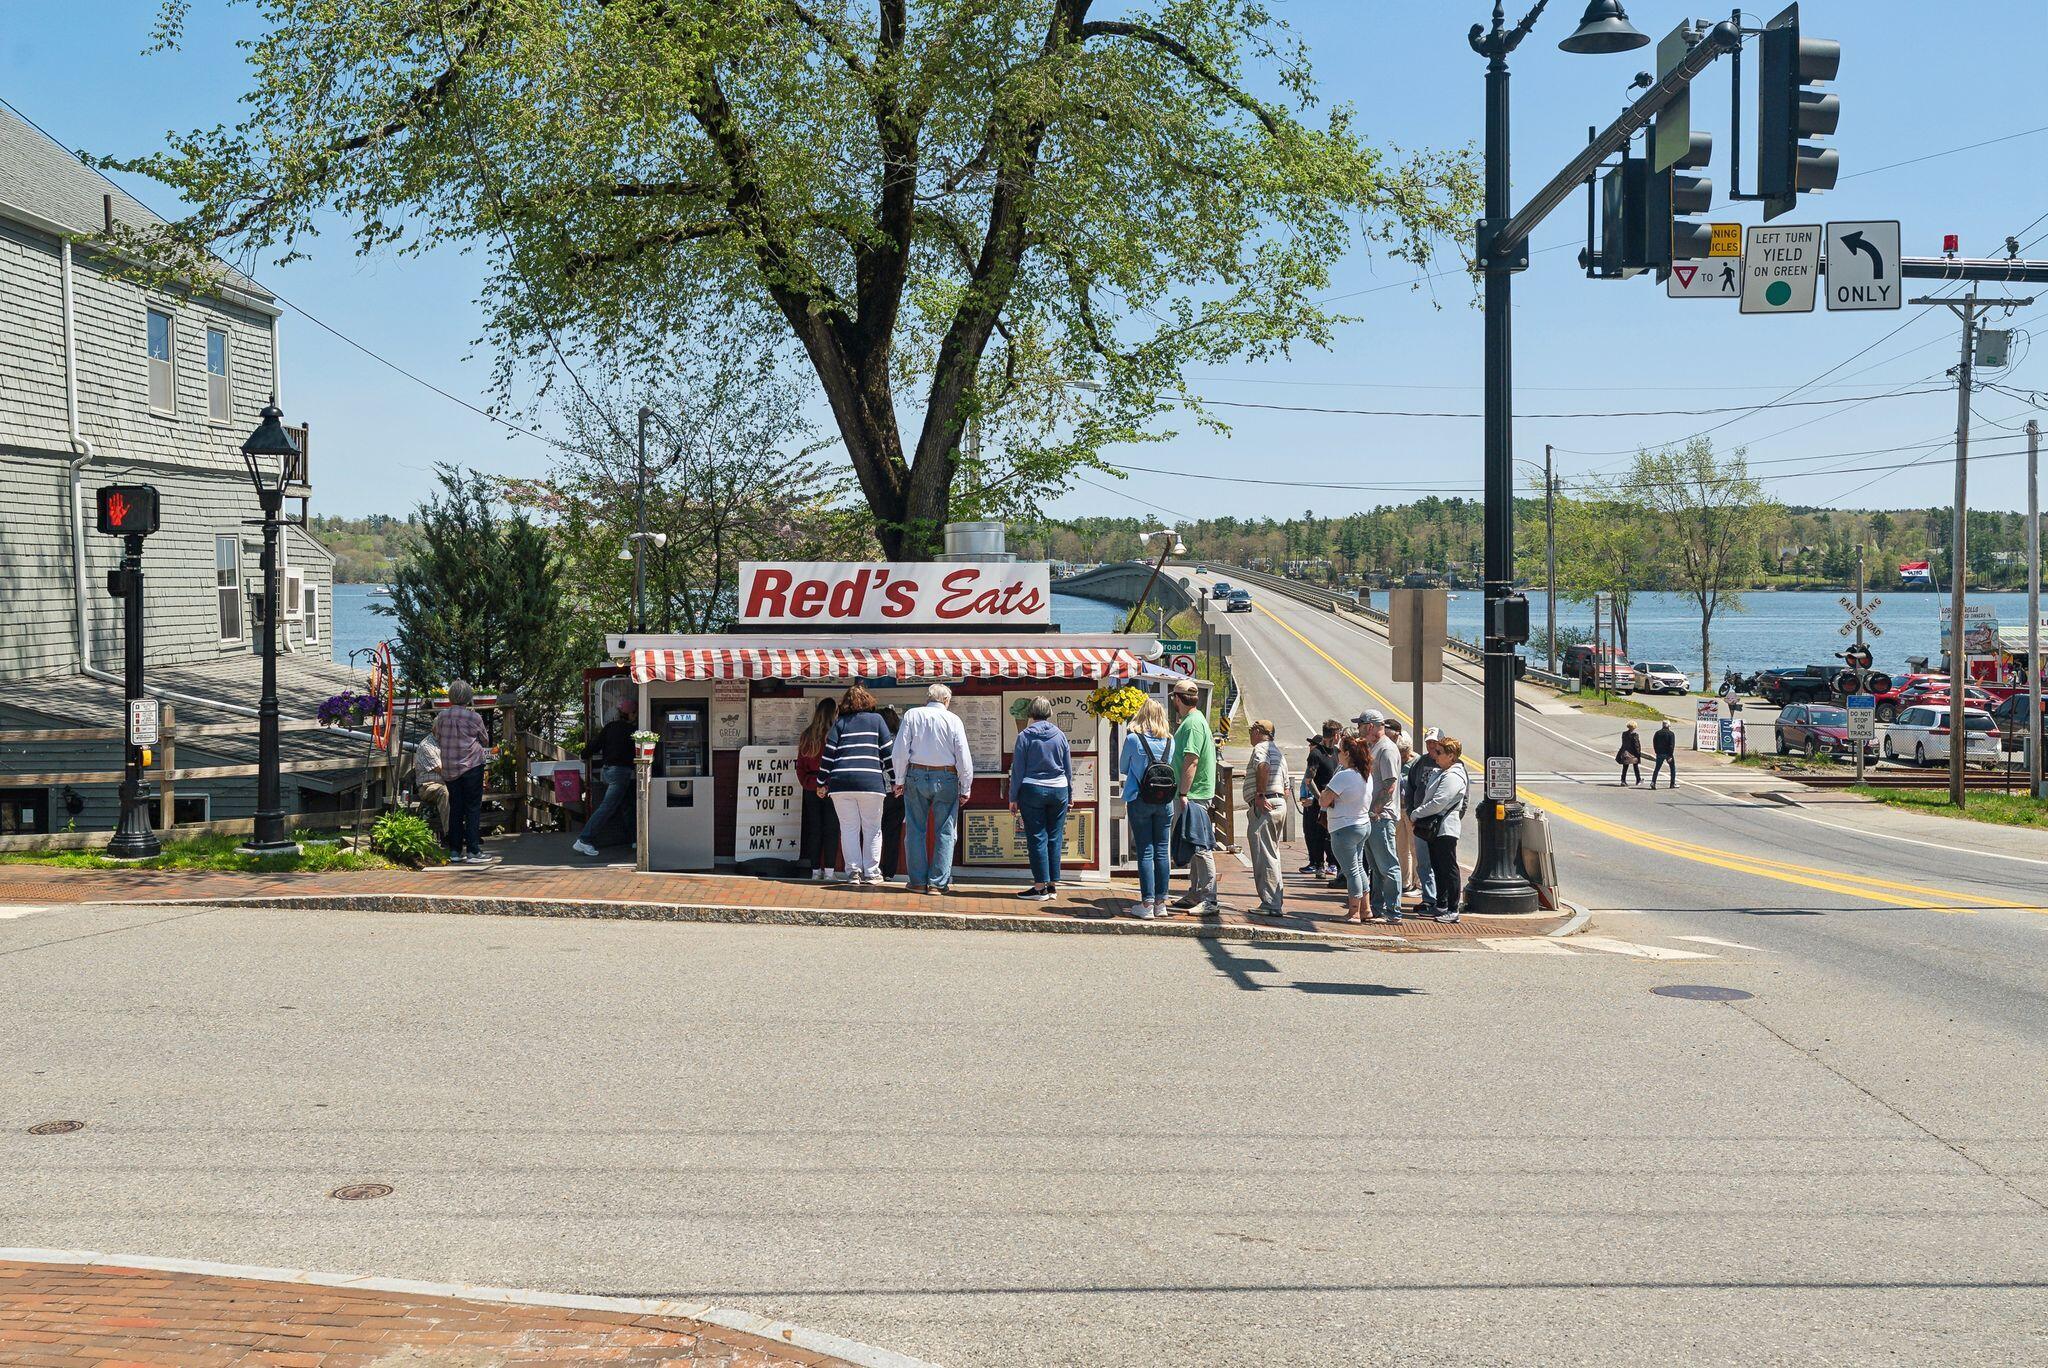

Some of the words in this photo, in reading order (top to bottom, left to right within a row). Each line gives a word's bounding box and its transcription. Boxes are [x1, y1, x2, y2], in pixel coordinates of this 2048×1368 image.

[1712, 230, 1737, 238] NING
[1756, 233, 1784, 244] LEFT
[1786, 232, 1812, 243] TURN
[1712, 242, 1739, 252] ICLES
[1764, 248, 1802, 262] YIELD
[1754, 266, 1768, 276] ON
[1774, 266, 1808, 276] GREEN
[1701, 273, 1714, 282] TO
[1838, 286, 1890, 302] ONLY
[744, 569, 919, 618] Red's
[936, 568, 1046, 619] Eats
[1839, 597, 1856, 616] RAIL
[1840, 598, 1882, 636] CROSSING
[1862, 619, 1881, 637] ROAD
[1049, 696, 1072, 707] UND
[719, 728, 741, 738] GREEN
[748, 760, 762, 770] WE
[770, 760, 798, 770] CAN'T
[638, 765, 646, 792] 41
[758, 773, 782, 783] WAIT
[747, 786, 760, 796] TO
[768, 786, 794, 796] FEED
[756, 800, 775, 810] YOU
[749, 826, 775, 836] OPEN
[749, 839, 771, 850] MAY
[777, 839, 783, 850] 7
